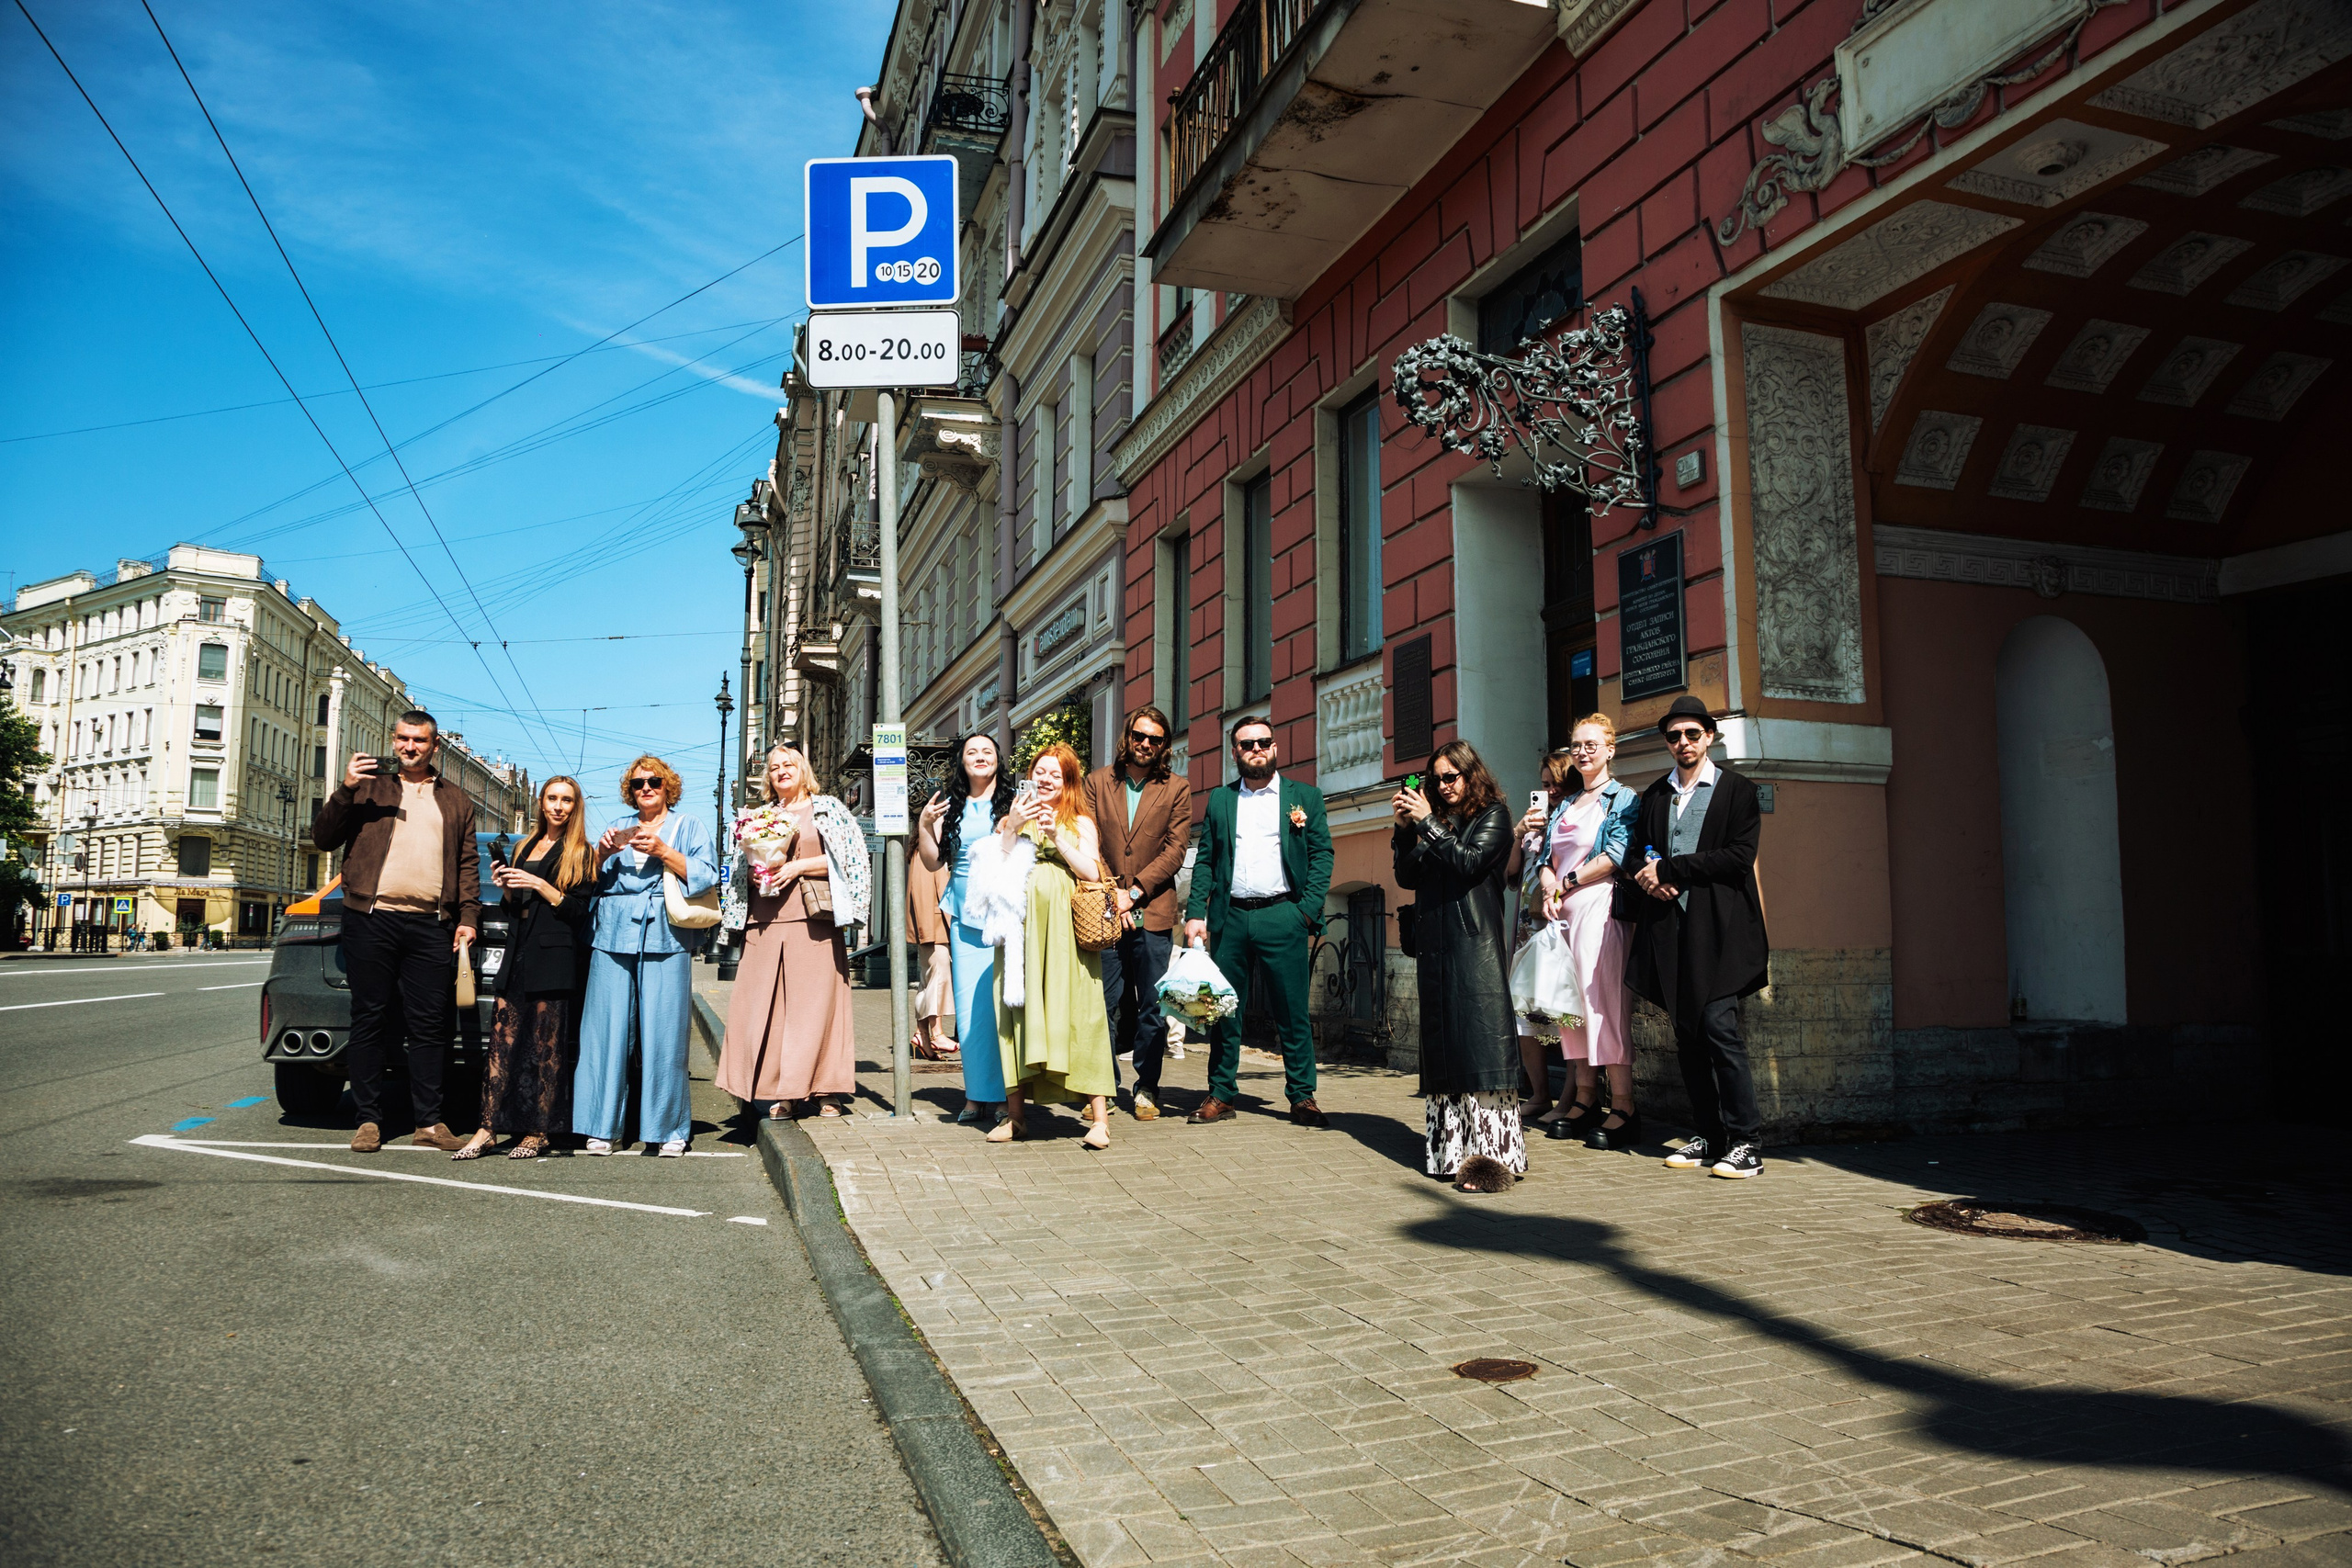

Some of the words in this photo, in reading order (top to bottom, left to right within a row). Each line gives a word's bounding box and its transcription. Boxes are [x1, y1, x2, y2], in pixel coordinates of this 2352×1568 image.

[851, 176, 928, 288] P
[881, 265, 892, 276] 10
[897, 265, 910, 277] 15
[917, 263, 940, 278] 20
[818, 338, 945, 361] 8.00-20.00
[1626, 619, 1647, 632] ОТДЕЛ
[1649, 611, 1674, 626] ЗАПИСИ
[1640, 626, 1661, 639] АКТОВ
[1625, 634, 1676, 654] ГРАЖДАНСКОГО
[1632, 647, 1670, 664] СОСТОЯНИЯ
[876, 734, 902, 744] 7801
[61, 895, 70, 905] P
